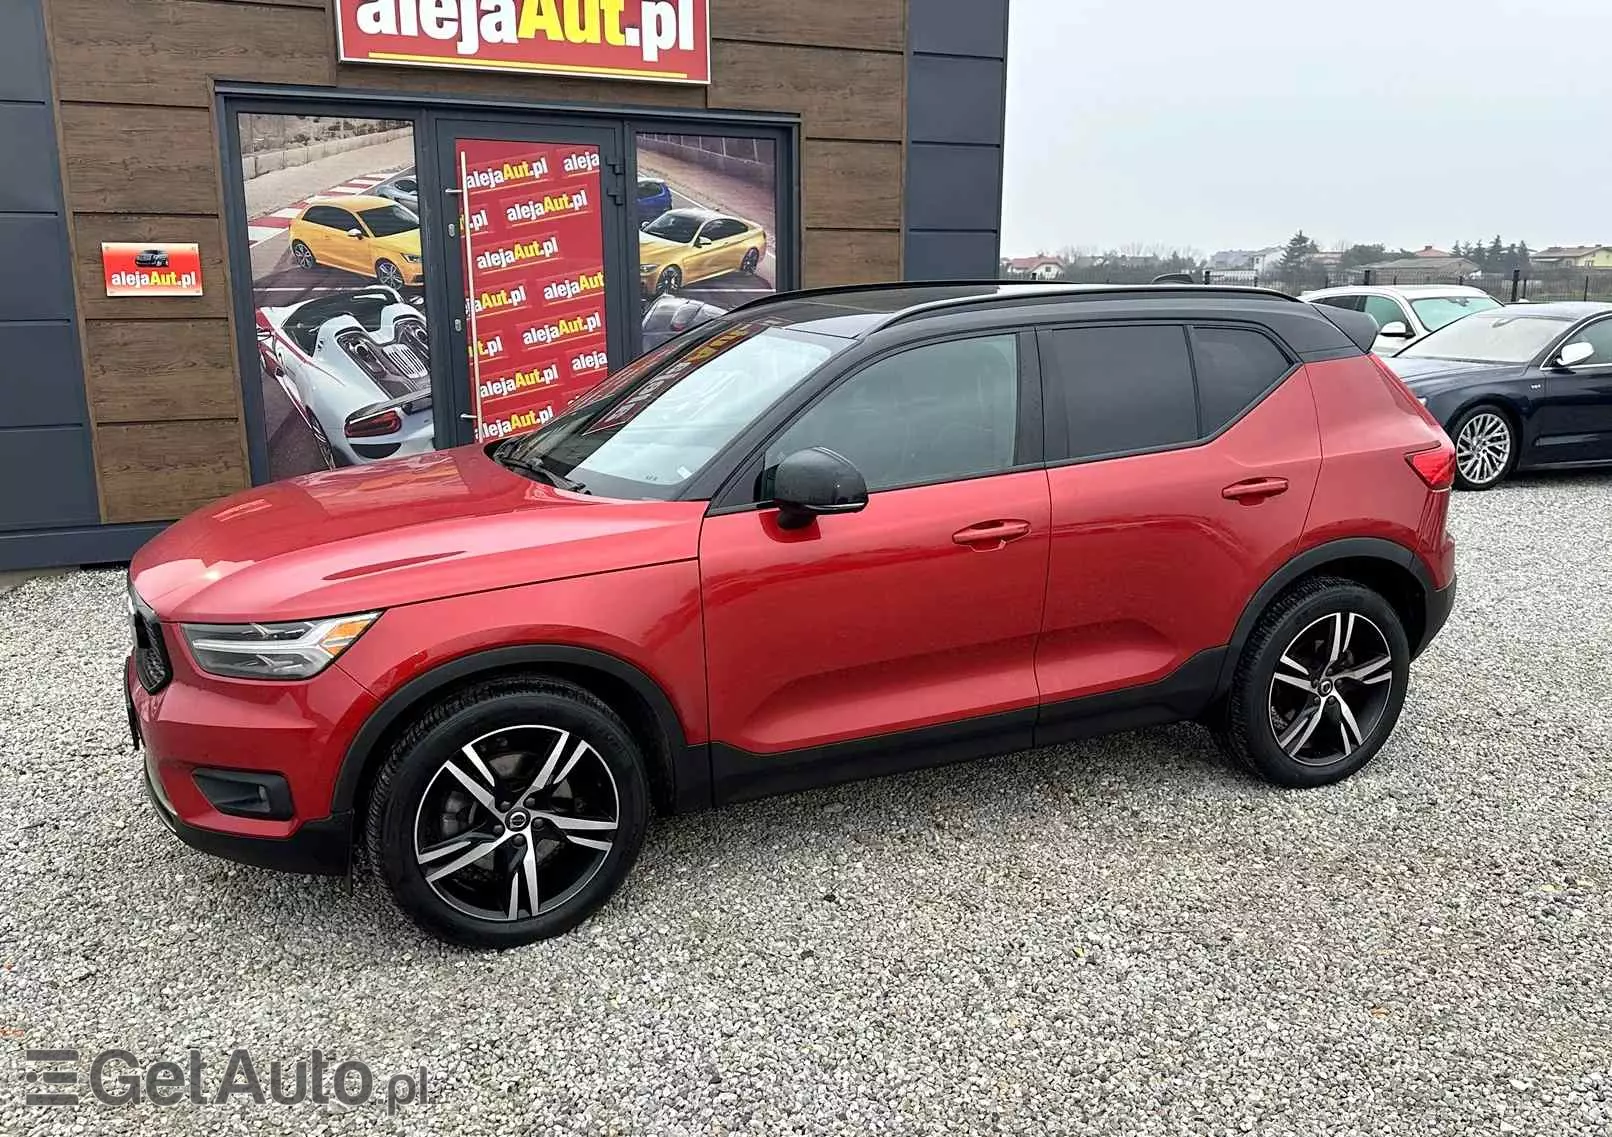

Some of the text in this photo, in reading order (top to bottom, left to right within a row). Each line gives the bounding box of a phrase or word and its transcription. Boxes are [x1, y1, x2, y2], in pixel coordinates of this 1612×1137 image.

[356, 0, 695, 62] alejaAut.pl
[466, 157, 549, 188] alejaAut.pl
[563, 152, 600, 172] aleja
[506, 189, 588, 220] alejaAut.pl
[476, 237, 559, 269] alejaAut.pl
[111, 270, 196, 288] alejaAut.pl
[544, 271, 605, 300] alejaAut
[523, 312, 602, 344] alejaAut.pl
[571, 350, 608, 371] aleja
[480, 364, 559, 397] alejaAut.pl
